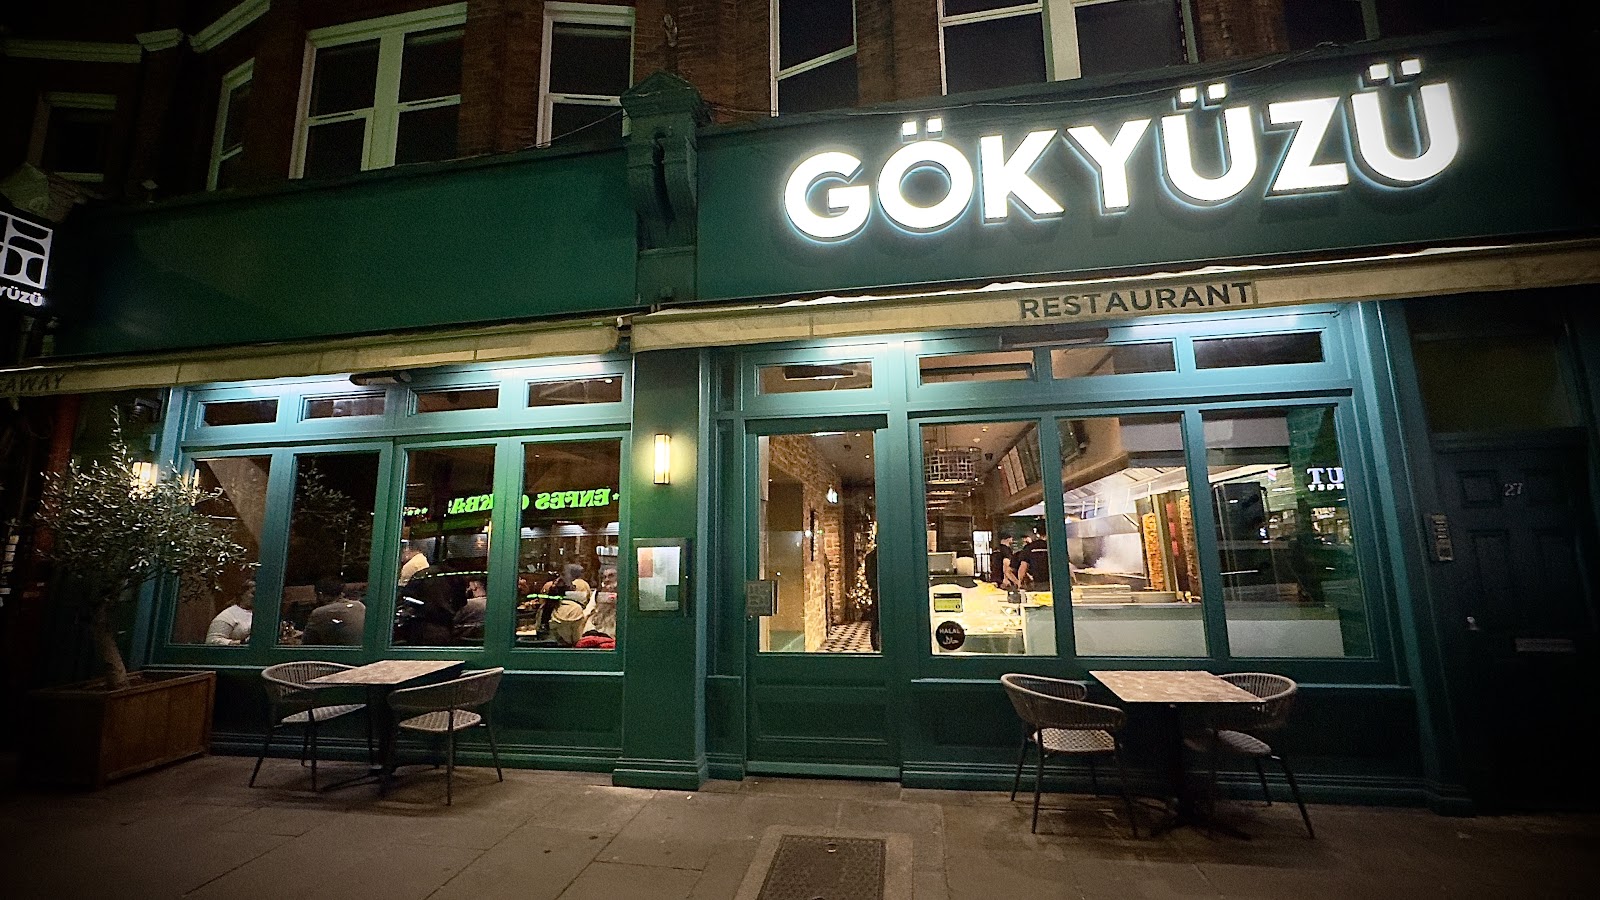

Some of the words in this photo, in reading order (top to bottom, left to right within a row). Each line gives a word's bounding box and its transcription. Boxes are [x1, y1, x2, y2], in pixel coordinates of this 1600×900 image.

[784, 58, 1460, 240] GÖKYÜZÜ
[1019, 281, 1252, 320] RESTAURANT
[0, 374, 64, 392] AWAY
[1504, 482, 1523, 497] 27
